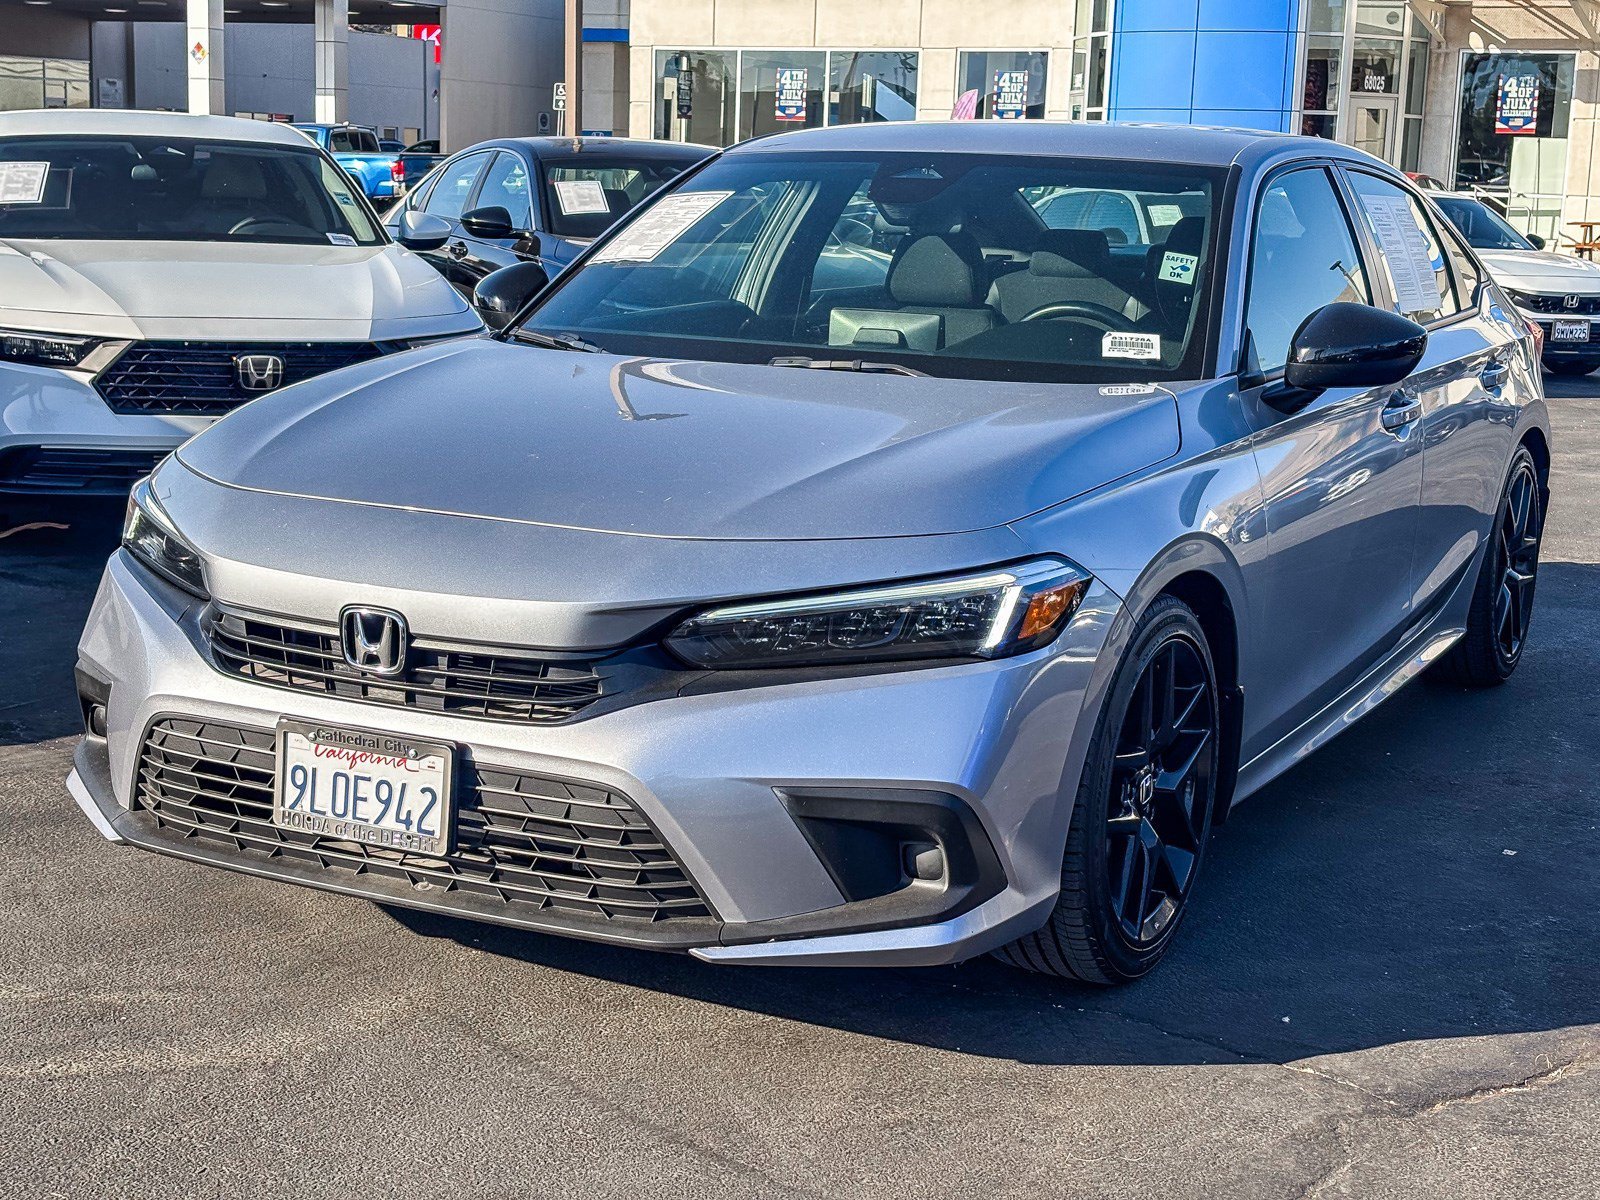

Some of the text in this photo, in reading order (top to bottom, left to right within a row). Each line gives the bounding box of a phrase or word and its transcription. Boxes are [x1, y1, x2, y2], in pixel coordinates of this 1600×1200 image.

[791, 80, 802, 89] OF
[1010, 82, 1023, 92] OF
[1364, 75, 1386, 91] 68025
[780, 89, 803, 100] JULY
[998, 92, 1023, 103] JULY
[1518, 87, 1533, 97] OF
[1502, 97, 1533, 109] JULY
[1165, 254, 1195, 265] SAFETY
[1169, 271, 1183, 279] OK
[316, 728, 411, 756] Cathedral City
[314, 743, 420, 773] California
[282, 810, 439, 852] HONDA of the DESERT
